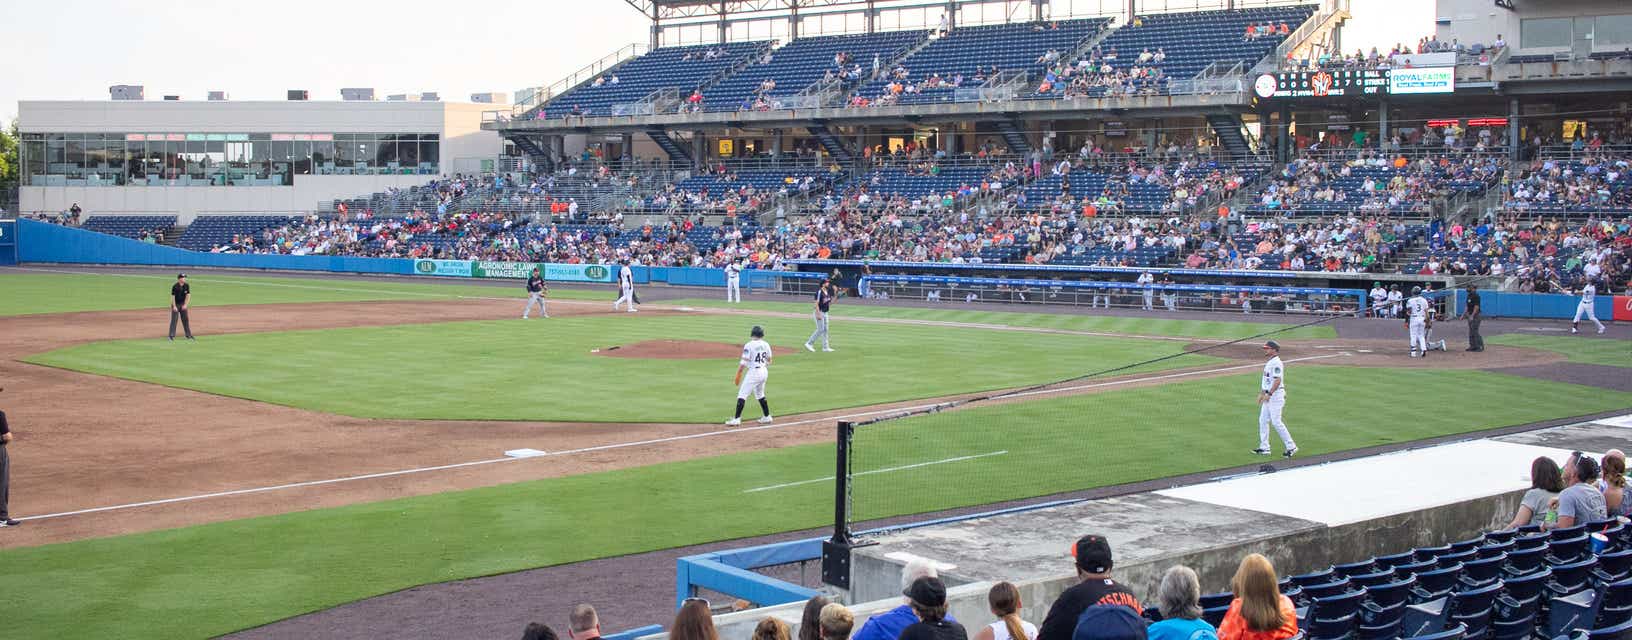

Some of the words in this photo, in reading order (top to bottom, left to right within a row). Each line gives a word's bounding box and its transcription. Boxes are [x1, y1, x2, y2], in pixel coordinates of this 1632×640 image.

[478, 260, 518, 270] AGRONOMIC
[485, 268, 532, 279] MANAGEMENT
[1416, 304, 1422, 312] 3
[754, 352, 768, 364] 48
